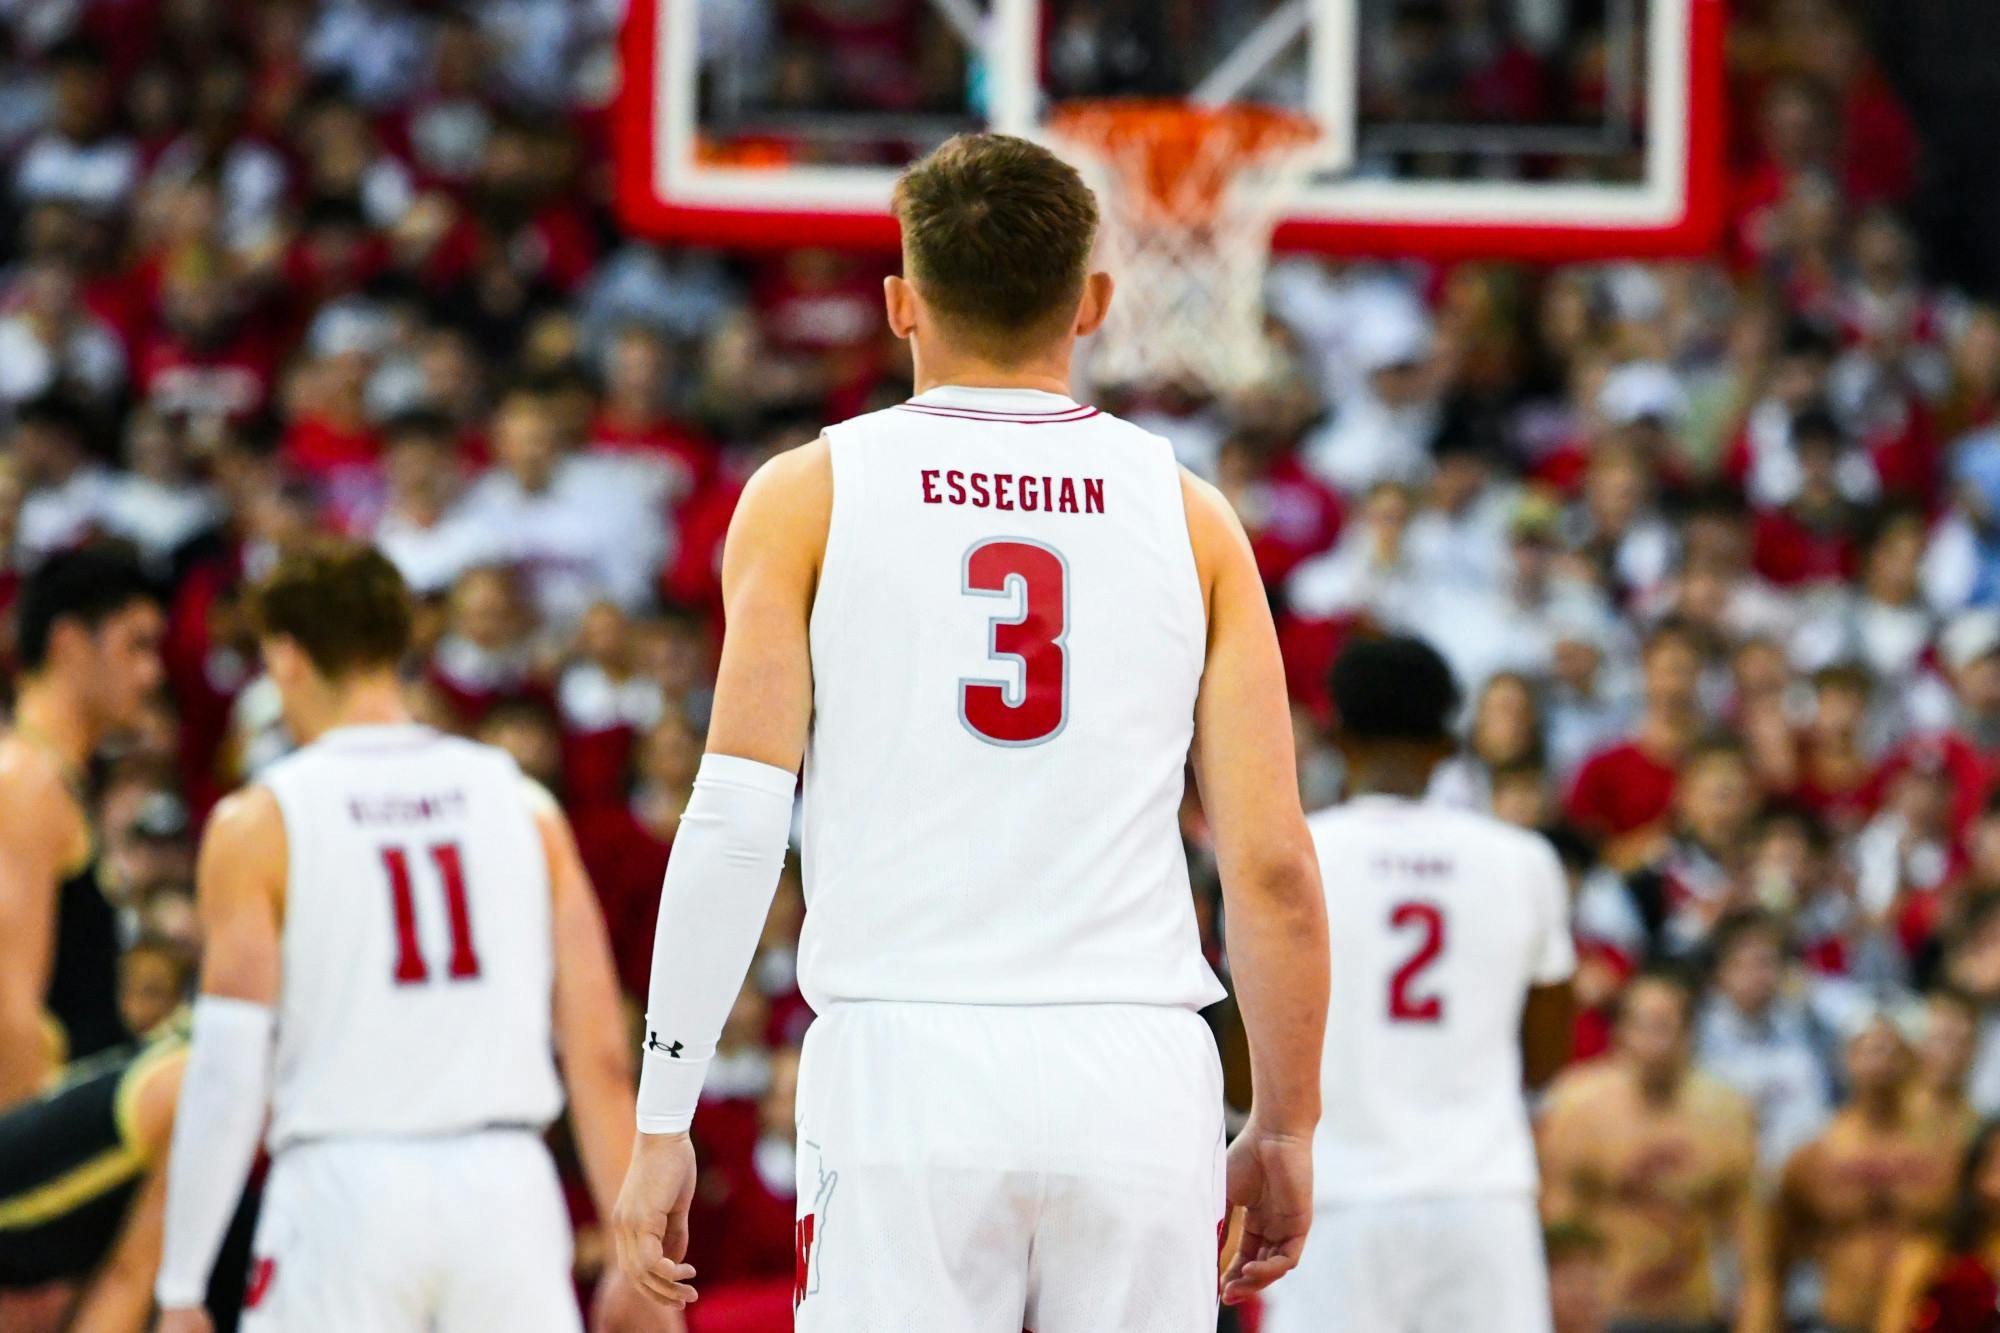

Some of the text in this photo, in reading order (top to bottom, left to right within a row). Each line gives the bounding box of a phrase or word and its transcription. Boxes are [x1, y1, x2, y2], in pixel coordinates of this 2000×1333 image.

[921, 469, 1105, 514] ESSEGIAN
[957, 535, 1071, 749] 3
[379, 840, 481, 986] 11
[1389, 900, 1445, 1024] 2
